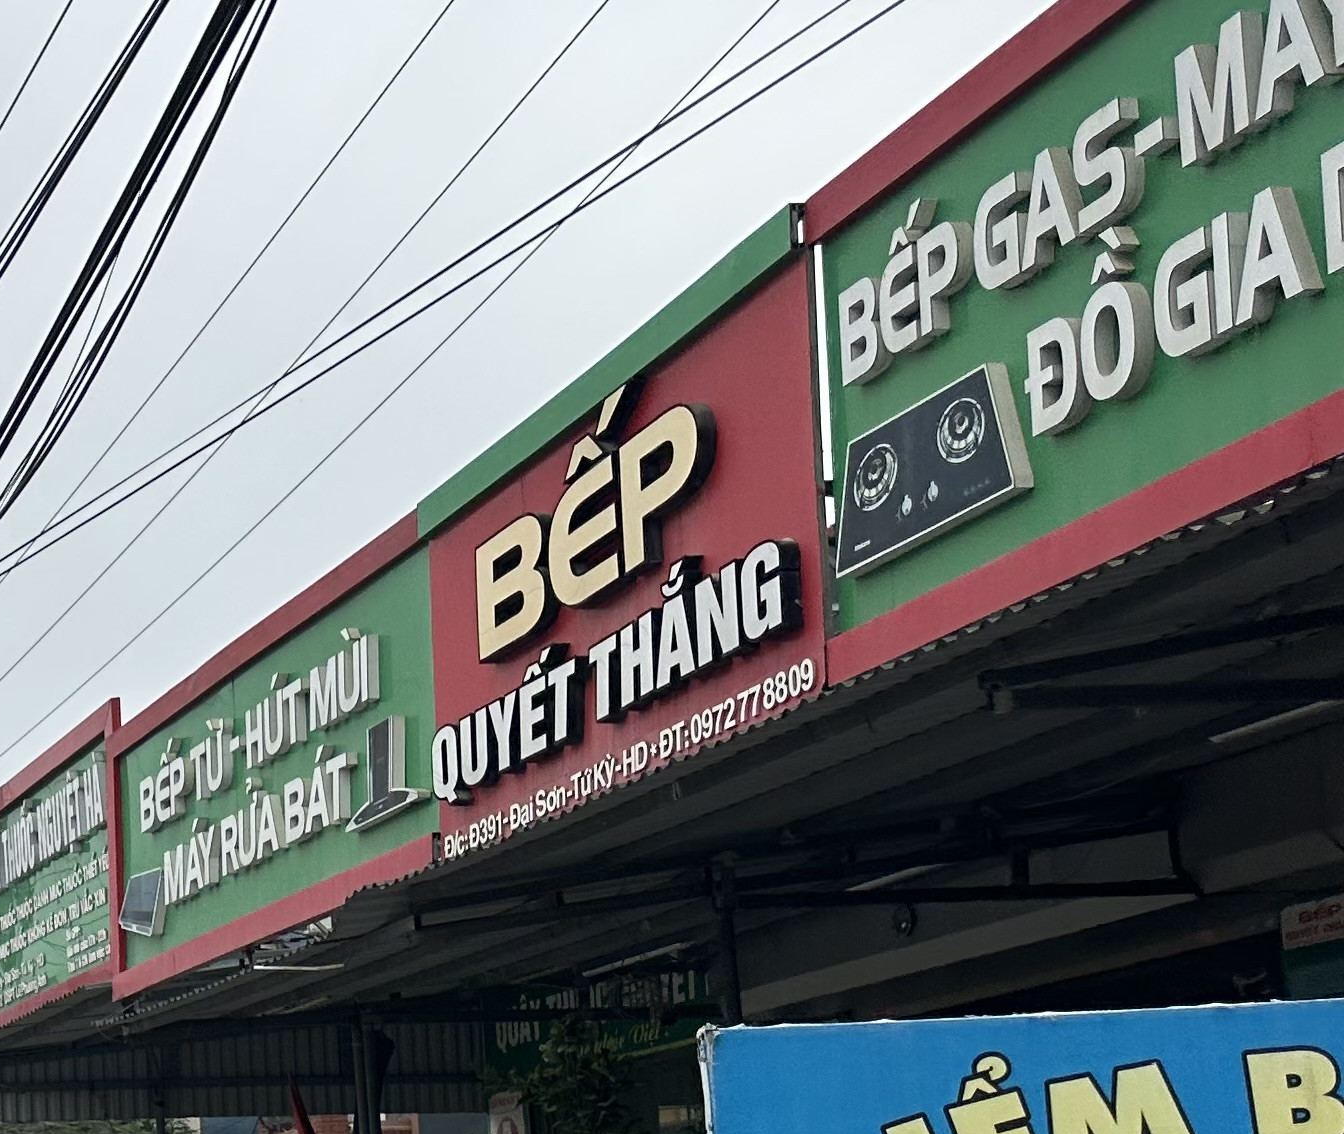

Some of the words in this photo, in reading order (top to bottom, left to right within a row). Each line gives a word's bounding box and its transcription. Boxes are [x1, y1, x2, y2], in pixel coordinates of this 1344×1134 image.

[838, 198, 964, 387] BẾP
[1025, 227, 1142, 436] ĐỒ
[1154, 186, 1316, 357] GIA
[475, 384, 702, 661] BẾP
[139, 738, 187, 833] BẾP
[190, 718, 226, 800] TỪ
[245, 673, 304, 769] HÚT
[309, 627, 374, 732] MÙI
[431, 646, 577, 803] QUYẾT
[590, 557, 788, 723] THẮNG
[2, 800, 36, 886] THUỐC
[163, 818, 216, 905] MÁY
[284, 744, 354, 844] BÁT
